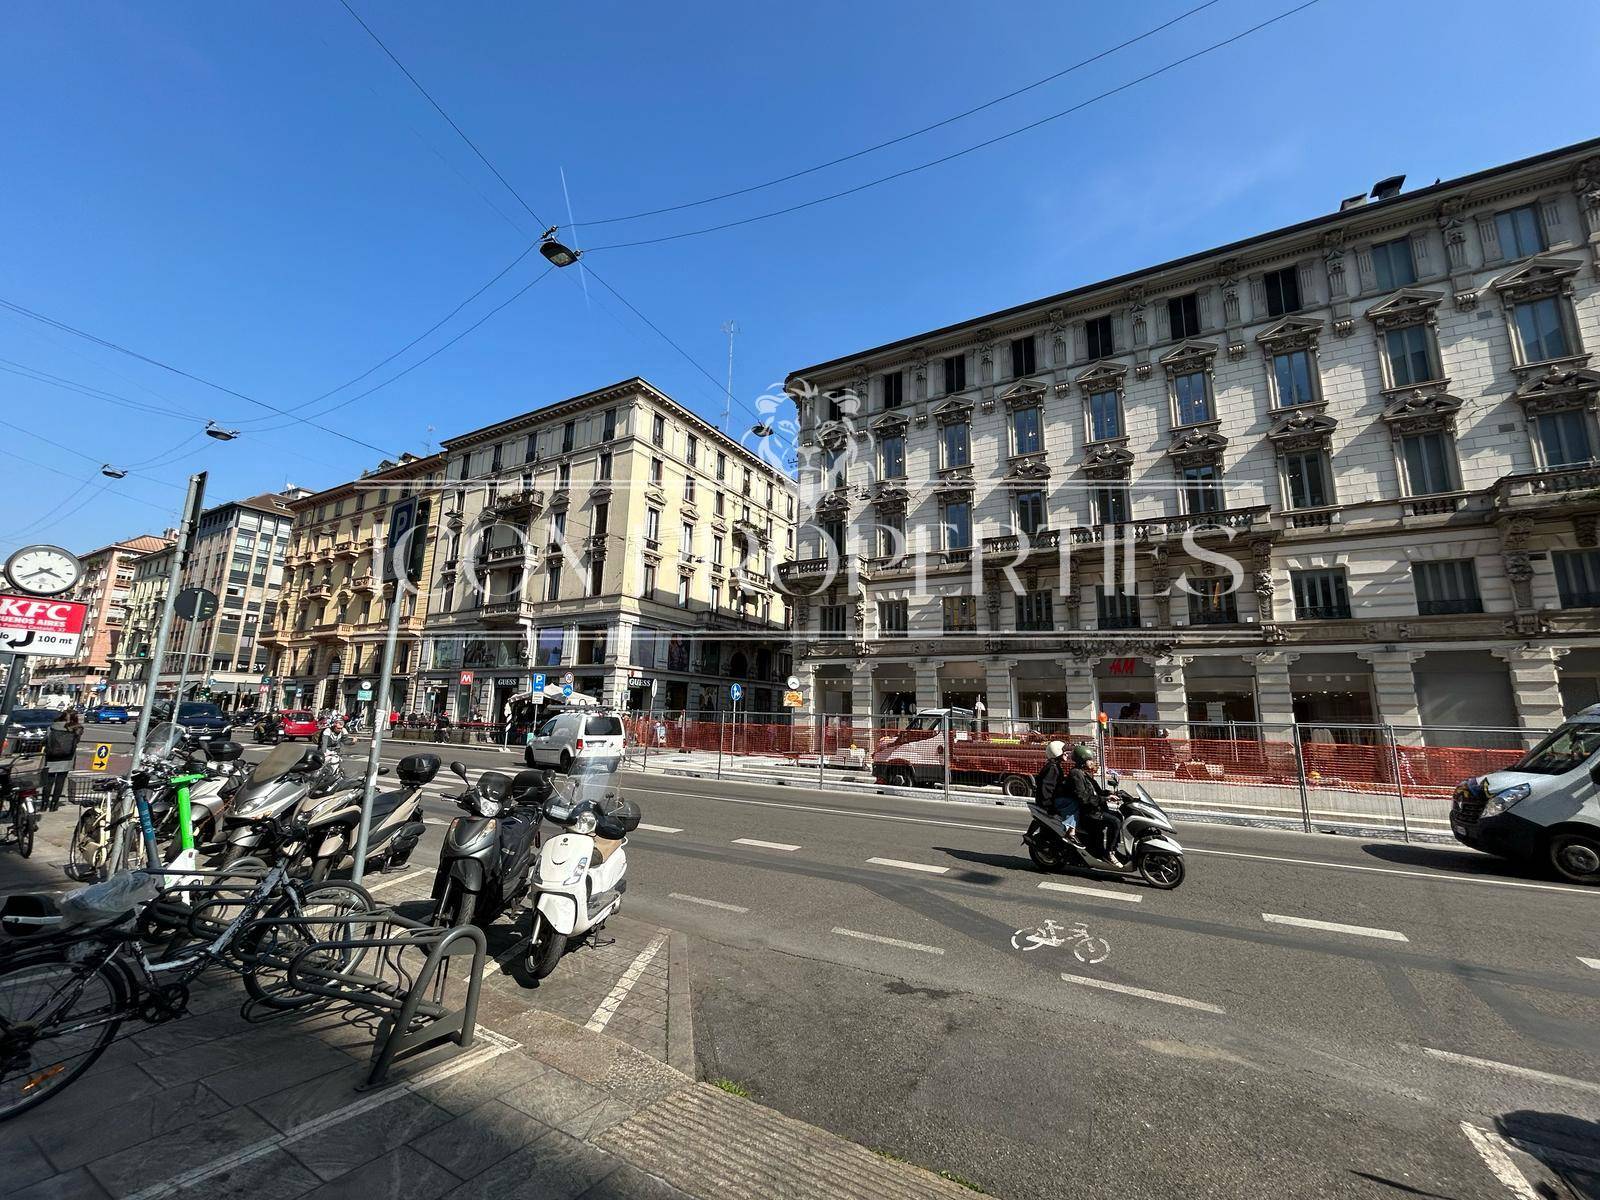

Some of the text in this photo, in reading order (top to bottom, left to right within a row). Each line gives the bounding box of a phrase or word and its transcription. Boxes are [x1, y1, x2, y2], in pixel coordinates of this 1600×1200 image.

[0, 598, 72, 621] KFC
[36, 619, 67, 628] AIRES
[38, 635, 57, 644] 100
[58, 637, 73, 645] mt
[498, 678, 517, 686] GUESS
[628, 678, 652, 687] GUESS
